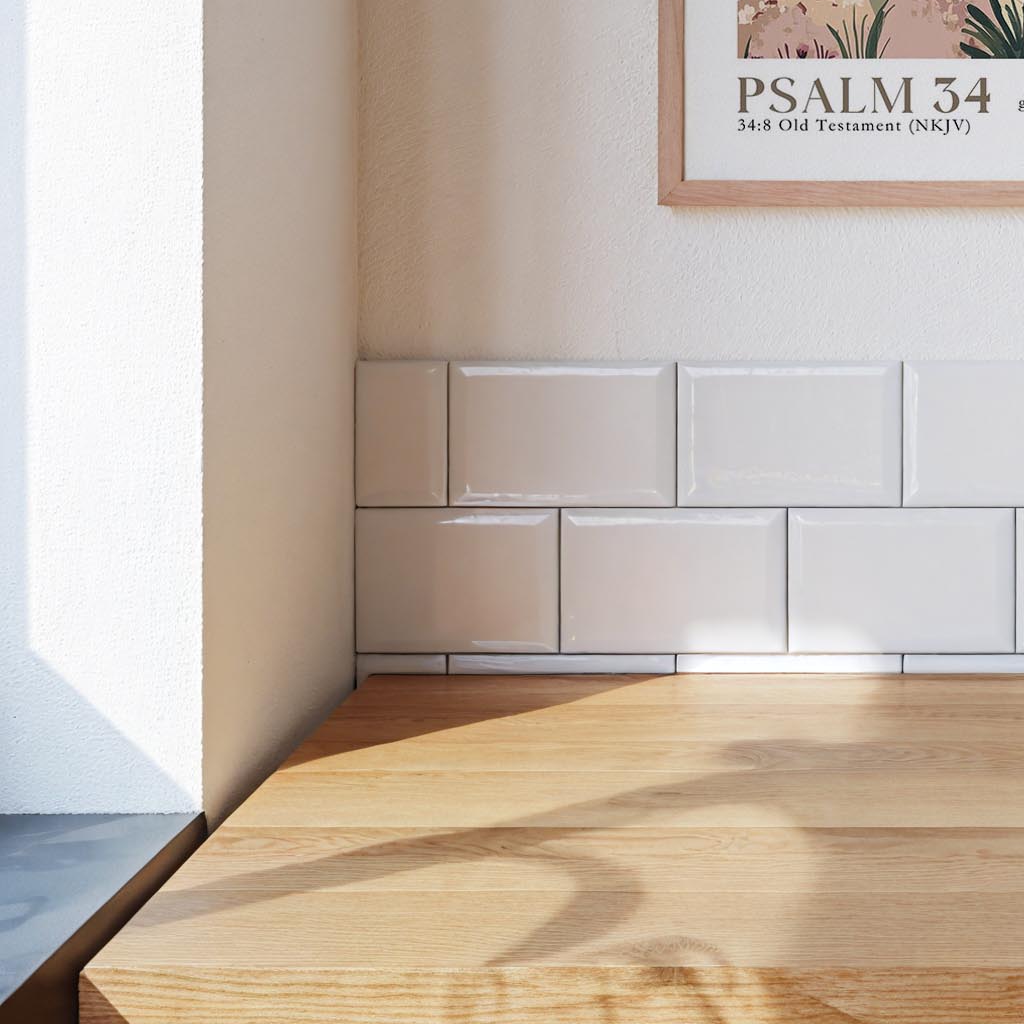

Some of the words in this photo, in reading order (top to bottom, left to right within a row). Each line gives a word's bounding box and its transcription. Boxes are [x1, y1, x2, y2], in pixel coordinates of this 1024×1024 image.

[737, 76, 914, 114] PSALM
[933, 77, 991, 114] 34
[737, 118, 772, 132] 34:8
[778, 118, 809, 132] Old
[815, 118, 901, 132] Testament
[908, 118, 971, 136] (NKJV)
